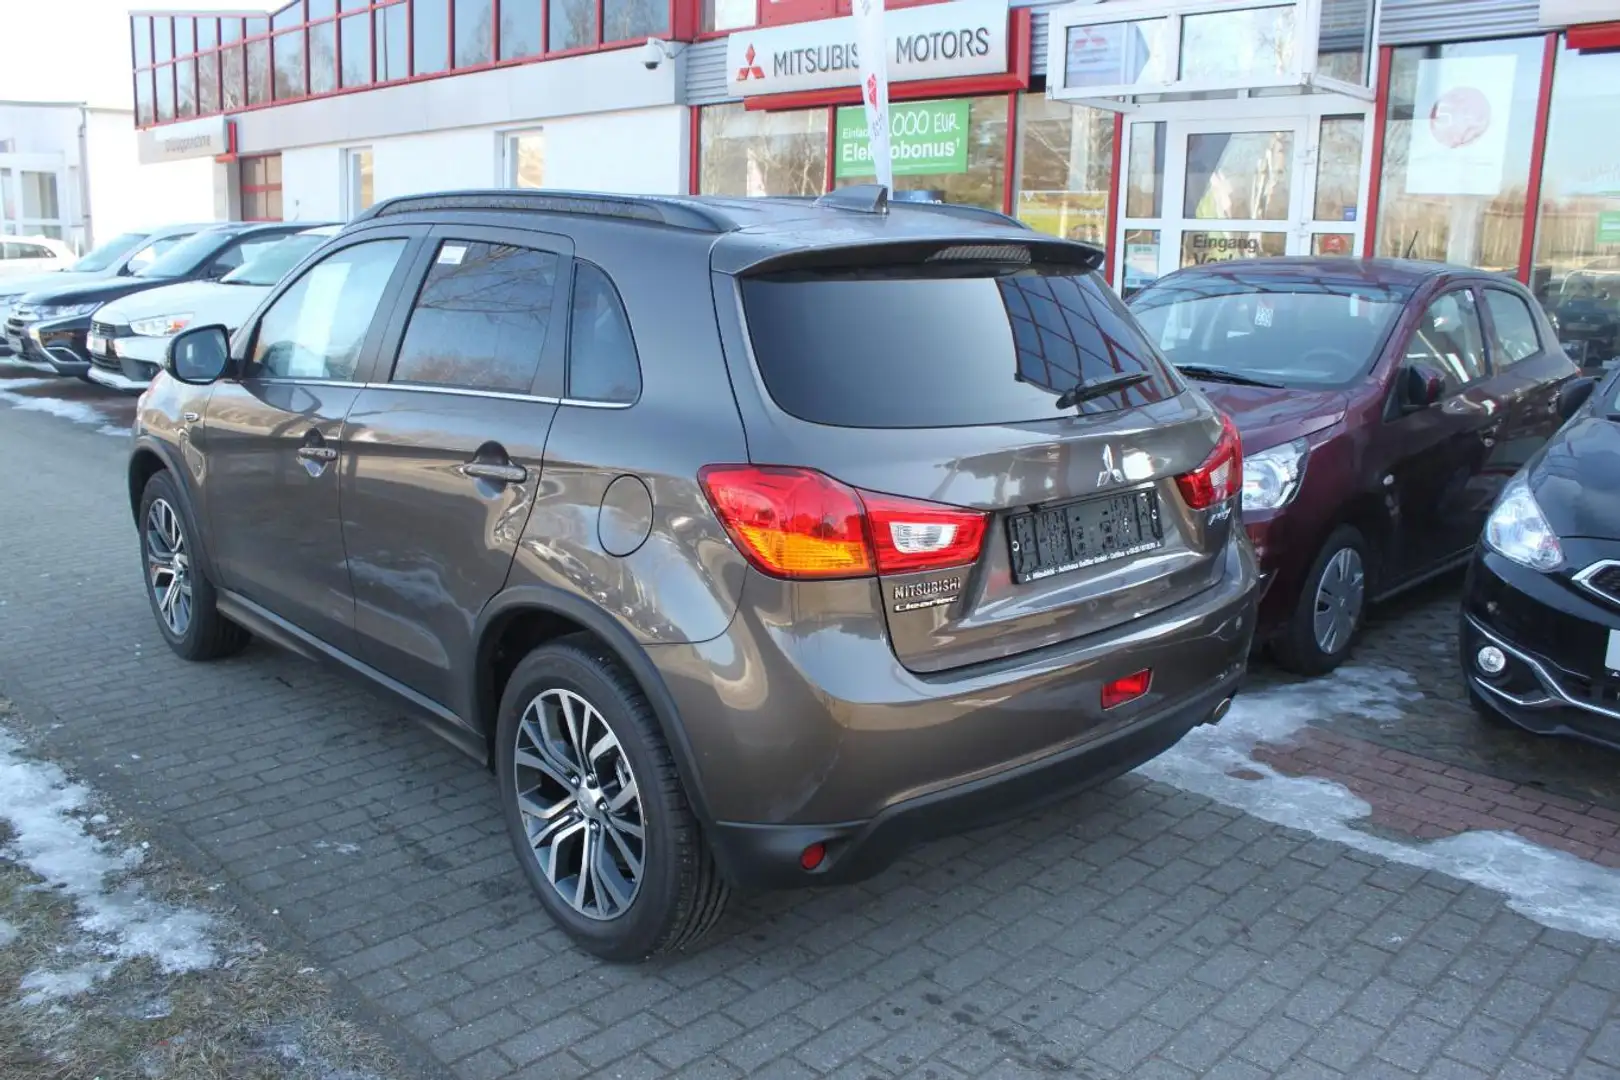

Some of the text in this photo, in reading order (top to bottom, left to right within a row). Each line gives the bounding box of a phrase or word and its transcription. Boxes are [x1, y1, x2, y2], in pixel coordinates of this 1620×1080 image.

[773, 27, 990, 77] MITSUBIS MOTORS
[1192, 233, 1258, 253] Eingang
[893, 576, 961, 600] MITSUBISHI
